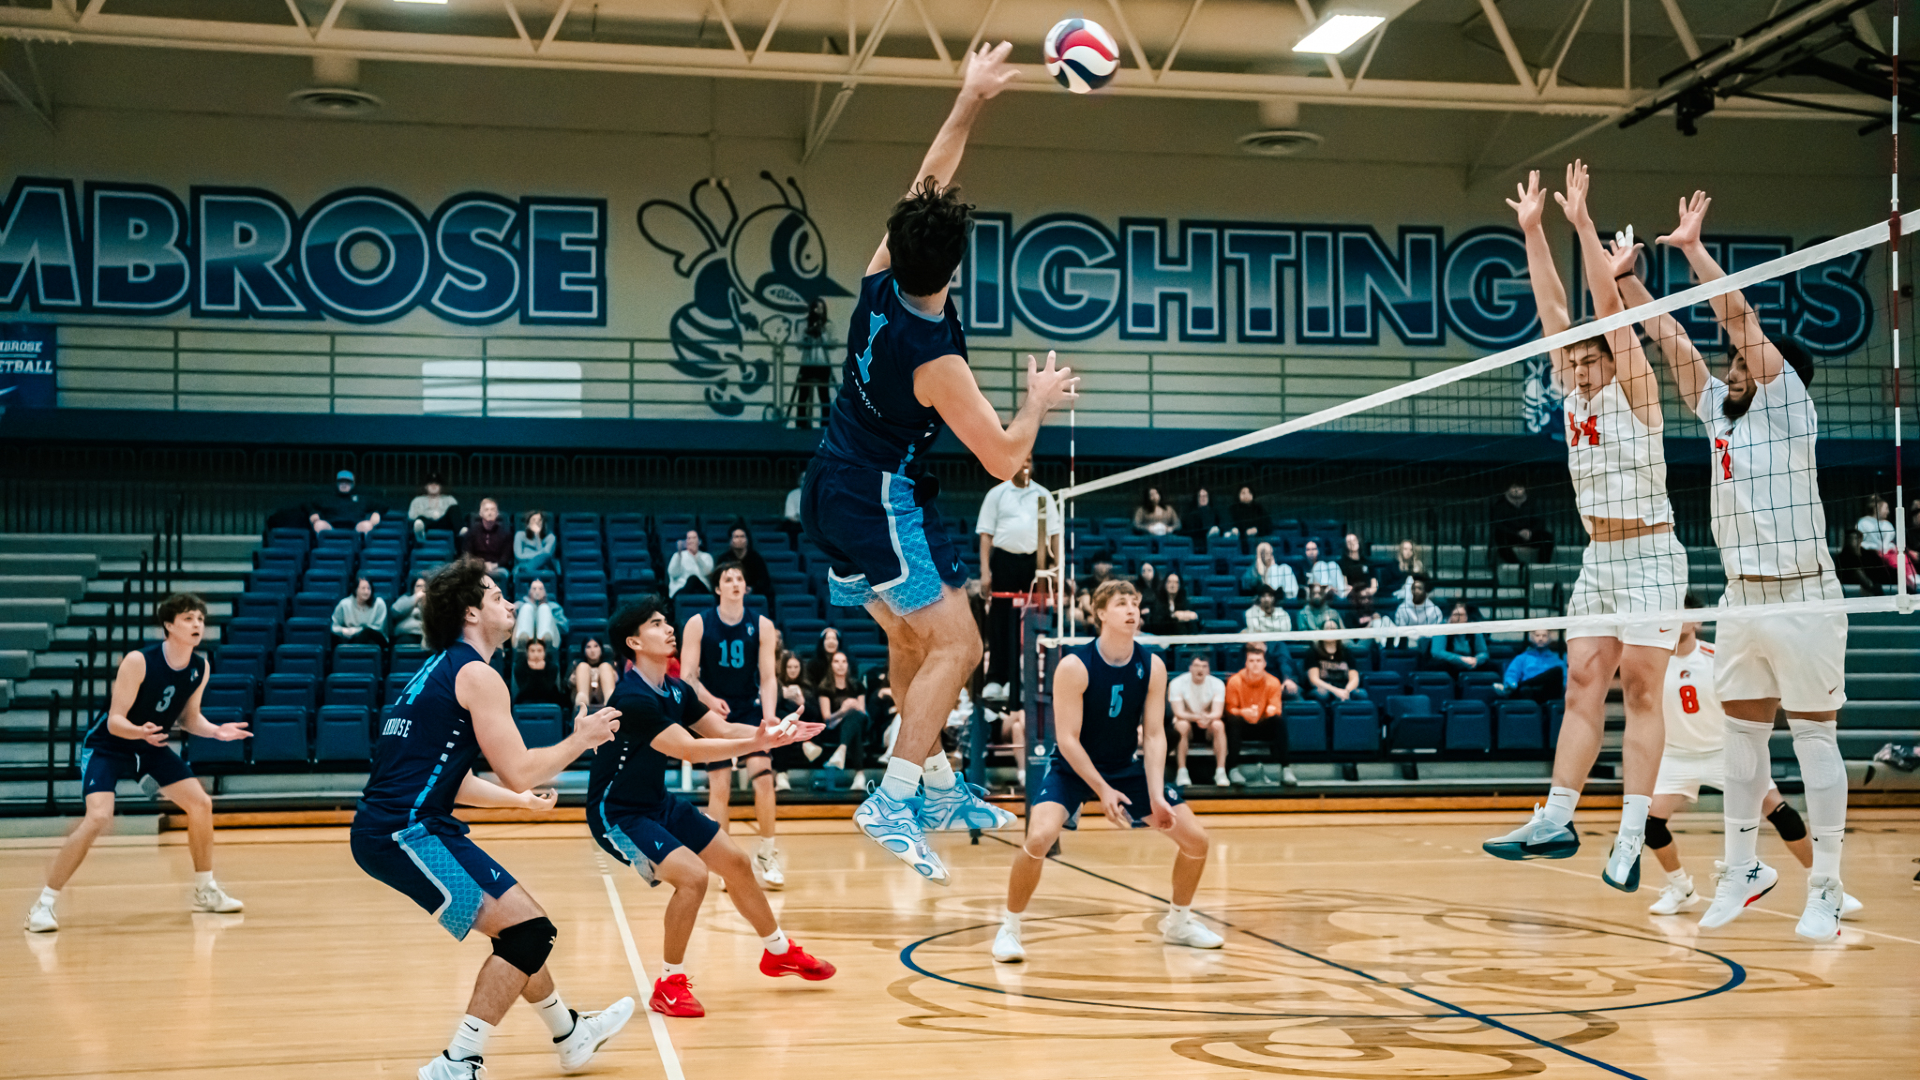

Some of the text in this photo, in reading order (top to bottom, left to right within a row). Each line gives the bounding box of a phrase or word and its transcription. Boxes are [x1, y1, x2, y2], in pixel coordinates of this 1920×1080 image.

[953, 212, 1545, 350] IGHTING
[718, 639, 745, 669] 19
[155, 685, 176, 712] 3
[1108, 683, 1124, 718] 5
[1679, 684, 1700, 714] 8
